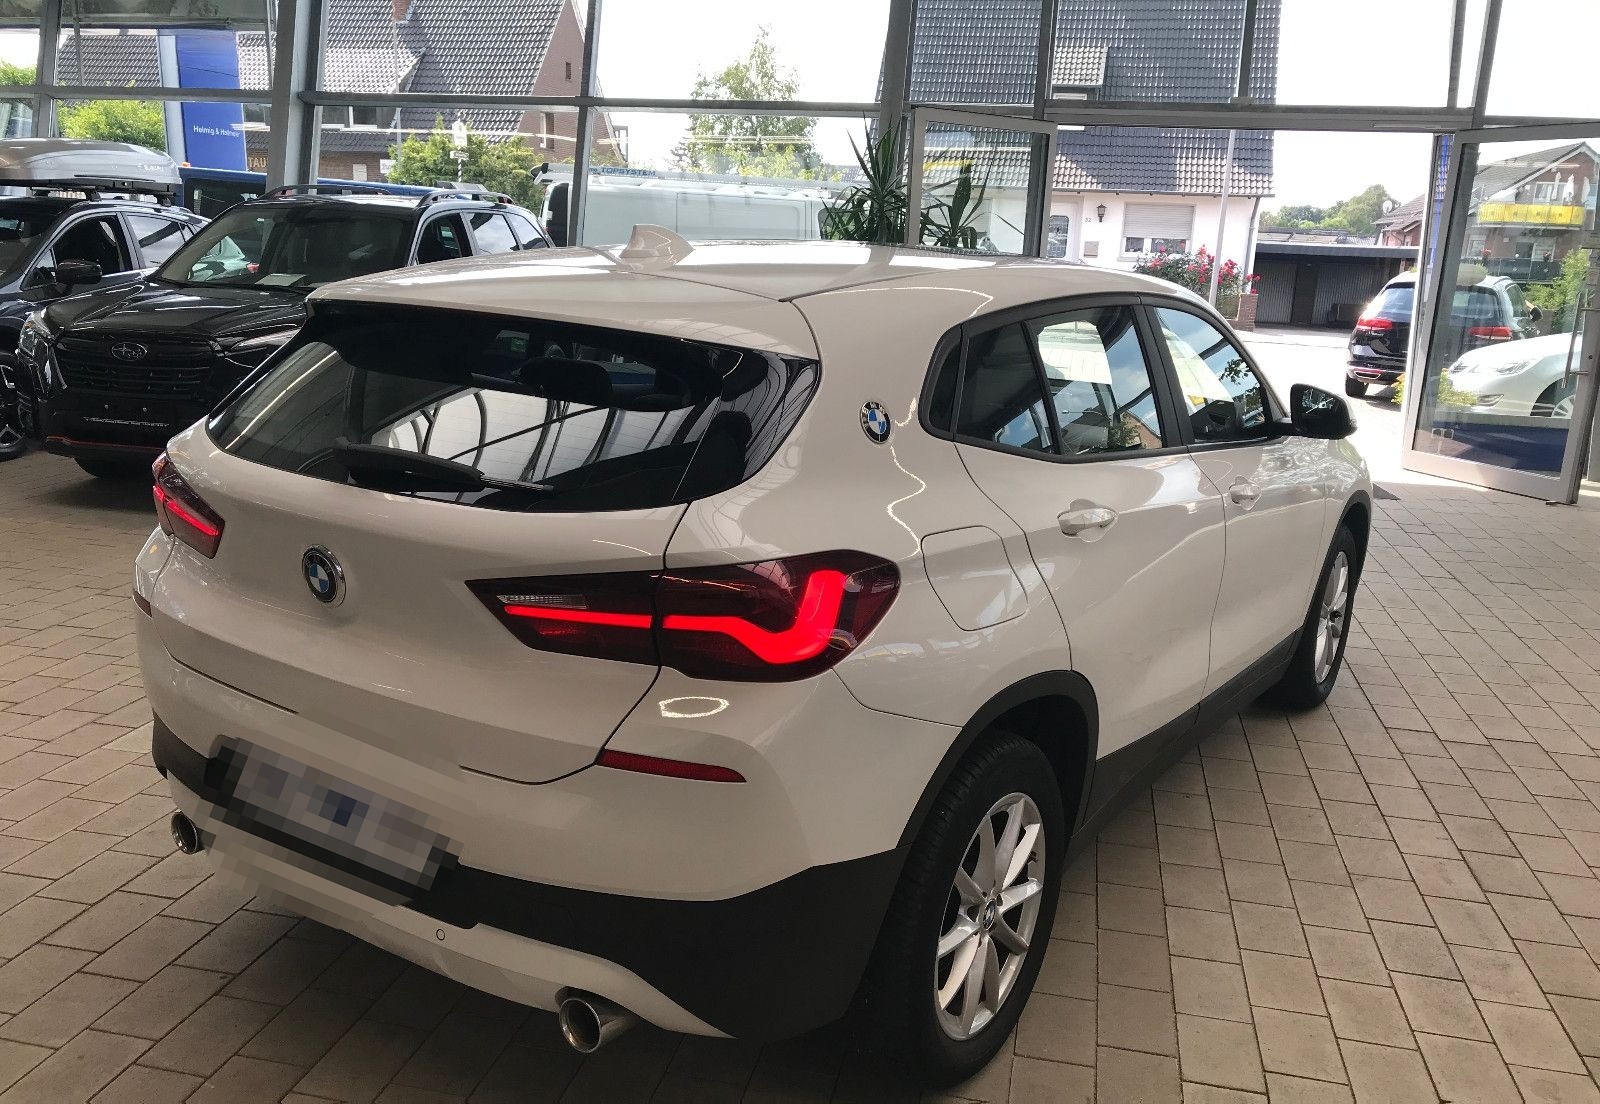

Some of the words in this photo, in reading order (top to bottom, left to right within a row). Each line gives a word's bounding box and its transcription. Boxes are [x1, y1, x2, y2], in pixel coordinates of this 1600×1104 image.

[215, 127, 220, 135] &
[248, 157, 267, 168] TAU
[601, 167, 656, 176] TOPSYSTEM
